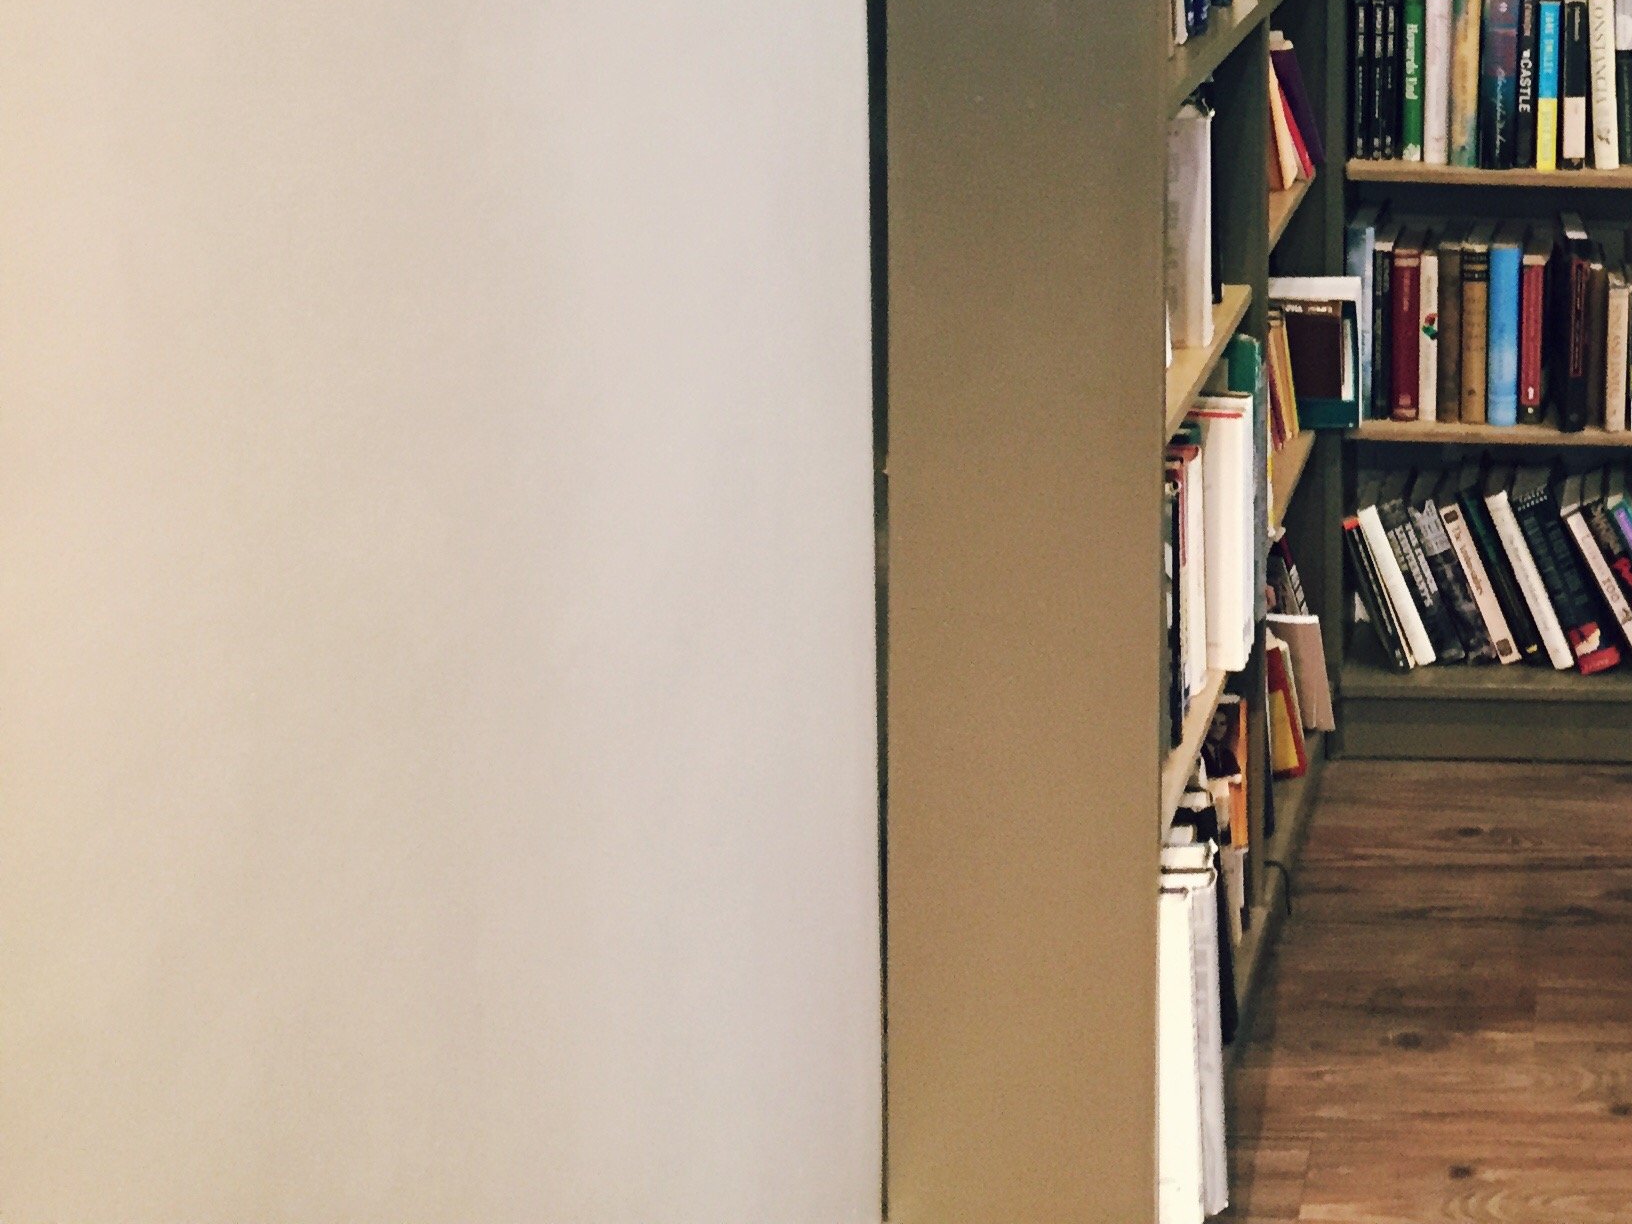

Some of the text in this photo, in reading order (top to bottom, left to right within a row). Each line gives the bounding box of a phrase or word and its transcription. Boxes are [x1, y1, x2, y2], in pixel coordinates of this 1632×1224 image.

[1405, 23, 1418, 99] Howards End
[1543, 11, 1555, 73] JANE SMILEY
[1519, 59, 1532, 113] CASTLE
